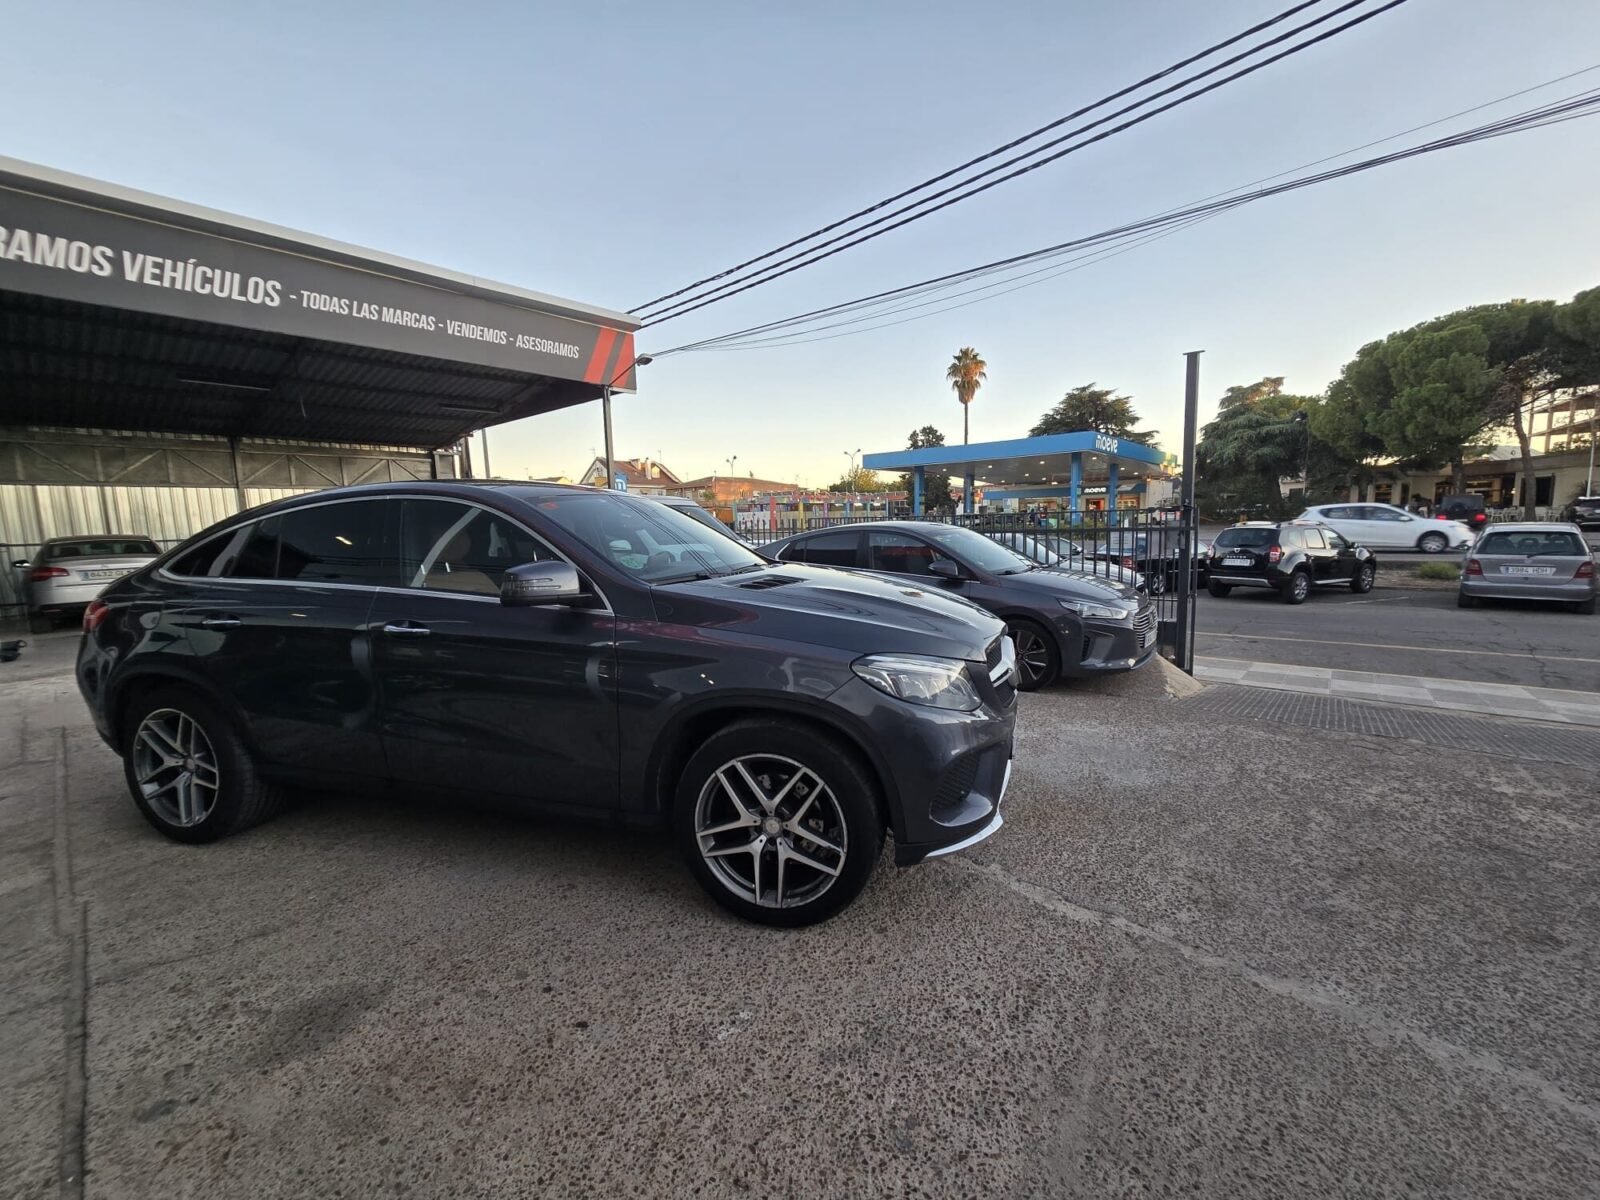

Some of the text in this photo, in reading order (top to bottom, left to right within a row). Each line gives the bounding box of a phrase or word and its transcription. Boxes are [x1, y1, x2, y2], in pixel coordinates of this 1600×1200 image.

[122, 250, 283, 308] VEHÍCULOS
[301, 290, 350, 315] TODAS
[352, 301, 380, 321] LAS
[382, 306, 436, 332] MARCAS
[446, 319, 508, 345] VENDEMOS
[515, 334, 580, 359] ASESORAMOS
